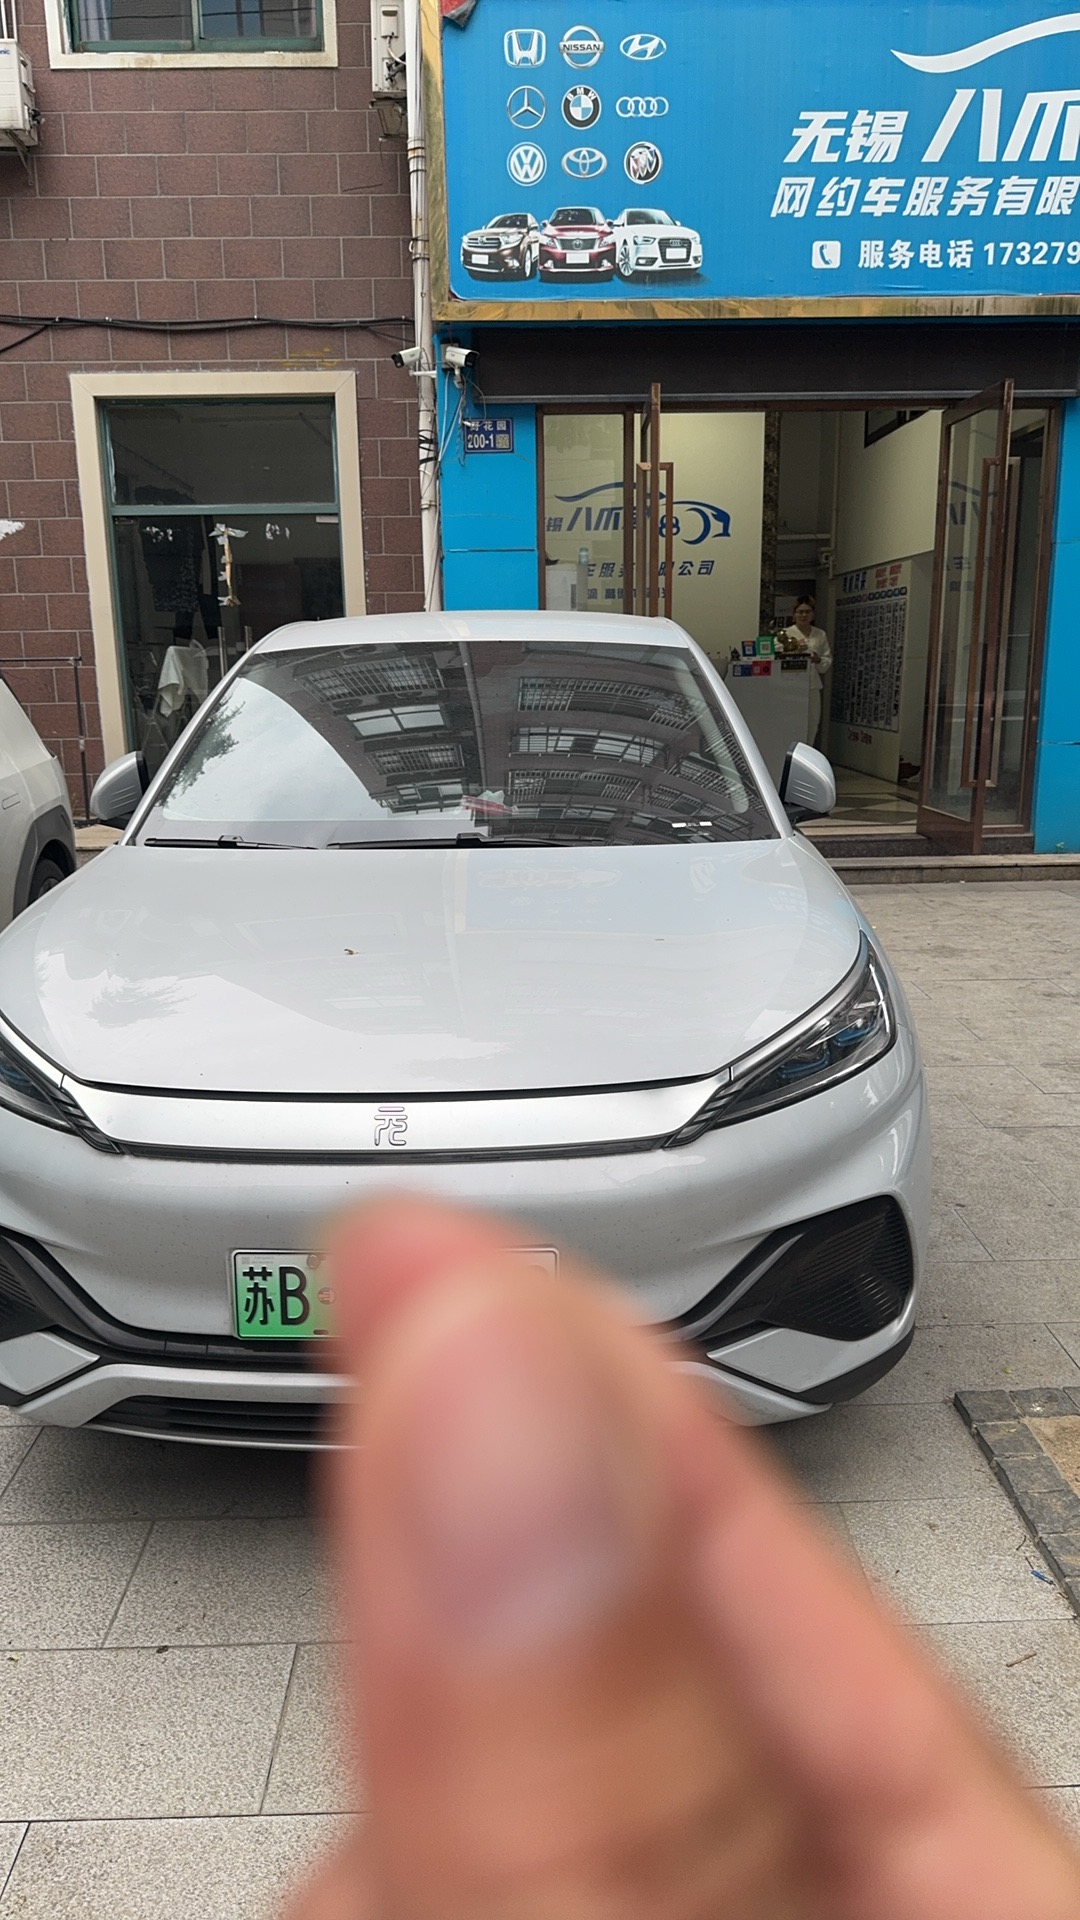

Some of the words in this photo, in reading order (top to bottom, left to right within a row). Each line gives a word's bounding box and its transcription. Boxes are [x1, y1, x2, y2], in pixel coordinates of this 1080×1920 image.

[562, 43, 601, 52] NISSAN
[566, 86, 597, 101] BMW
[783, 109, 909, 163] 无锡
[858, 240, 974, 269] 服务电话
[467, 433, 494, 448] 200-1
[374, 1106, 408, 1146] 元
